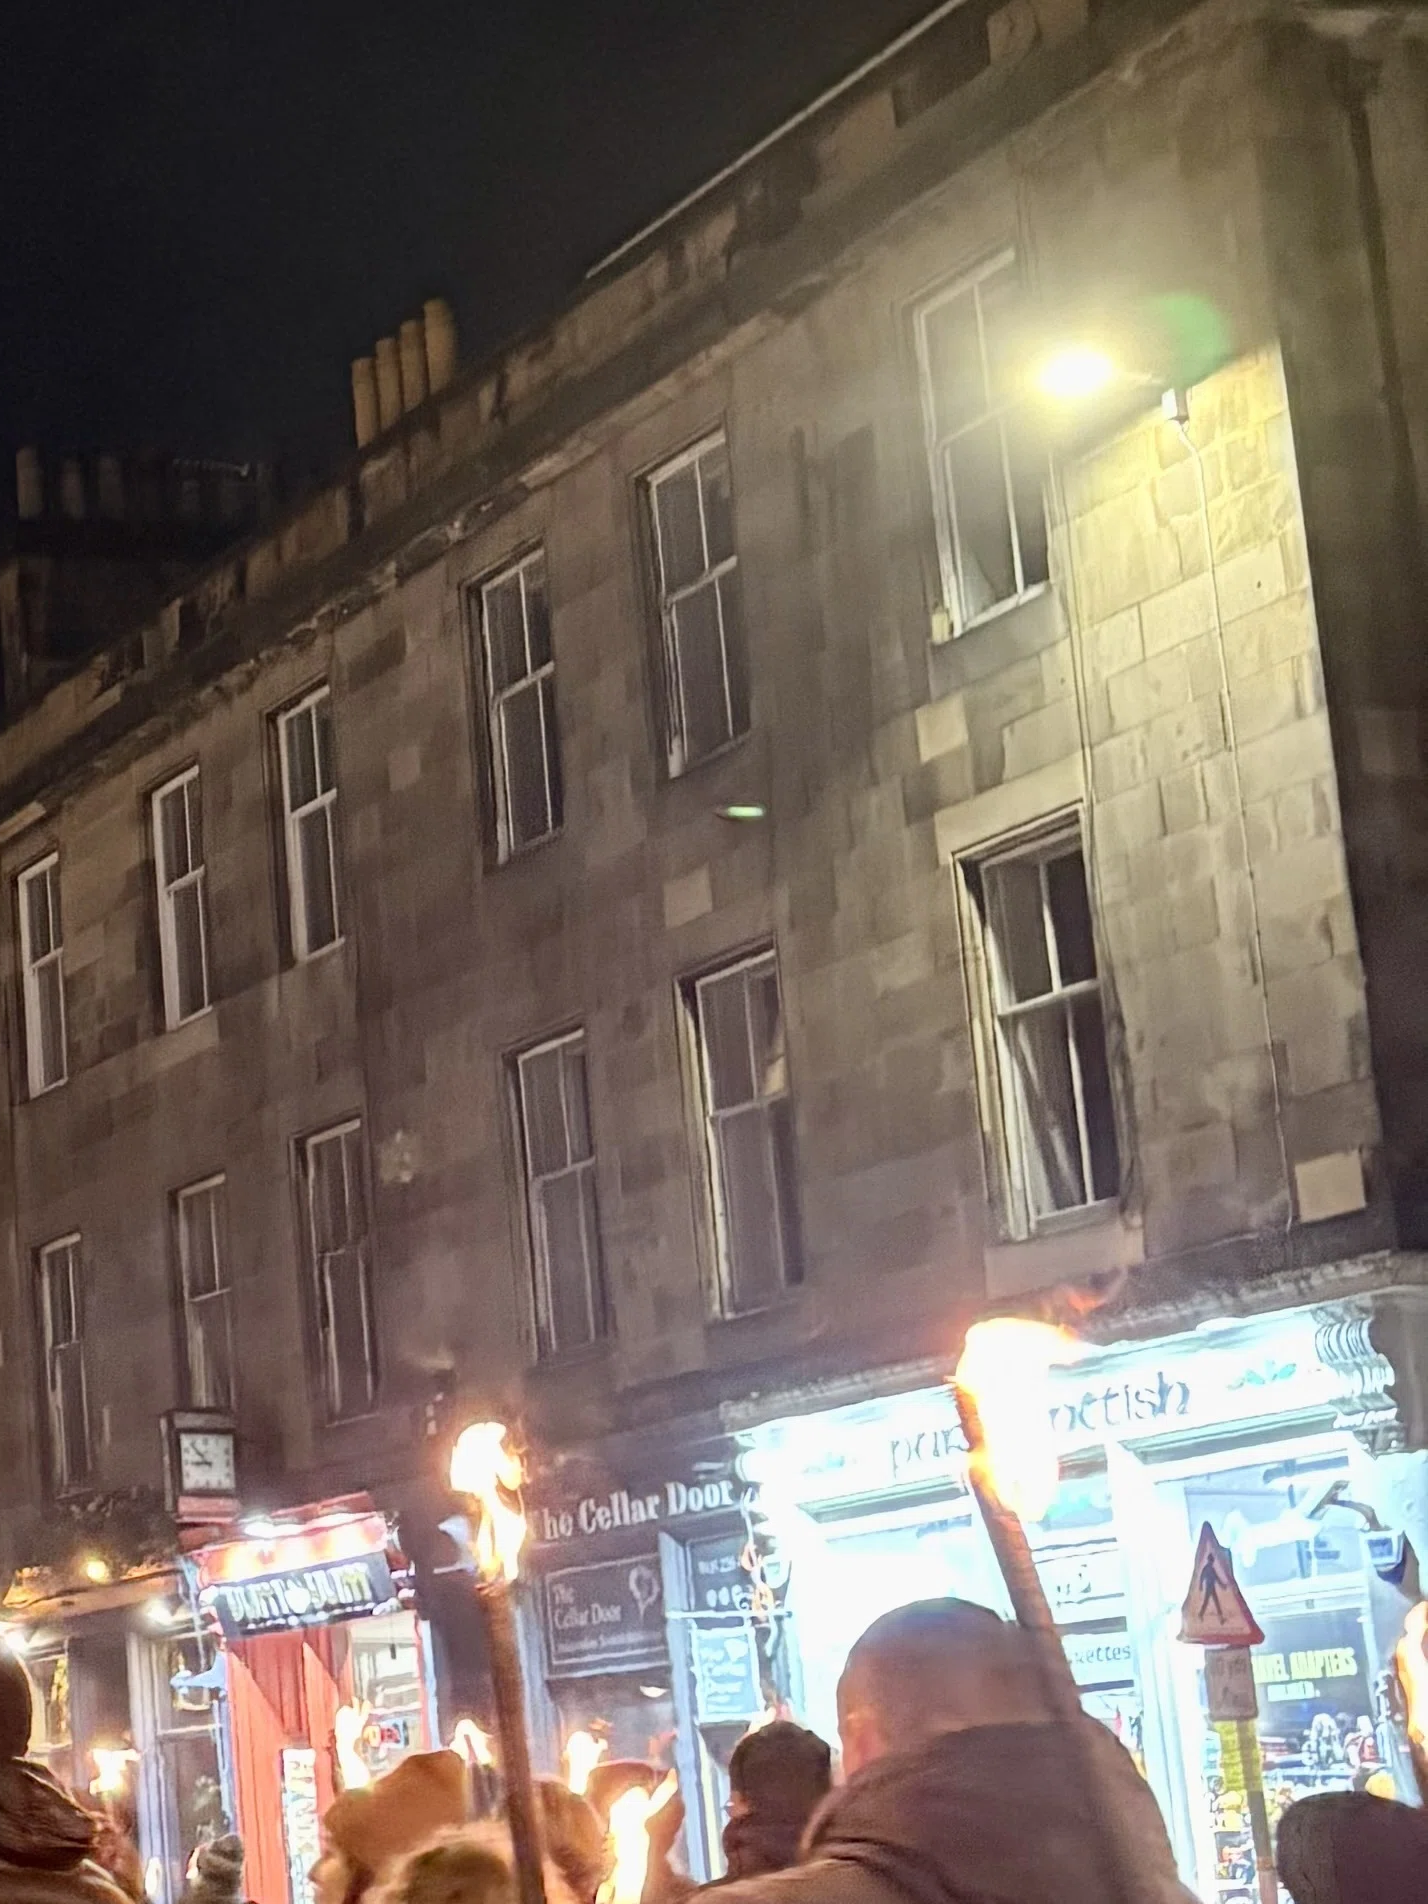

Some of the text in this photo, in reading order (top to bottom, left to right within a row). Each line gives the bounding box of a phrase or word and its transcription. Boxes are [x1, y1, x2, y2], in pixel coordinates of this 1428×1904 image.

[578, 1490, 660, 1534] Cellar
[664, 1479, 734, 1517] Door
[1289, 1647, 1358, 1680] ADAPTERS
